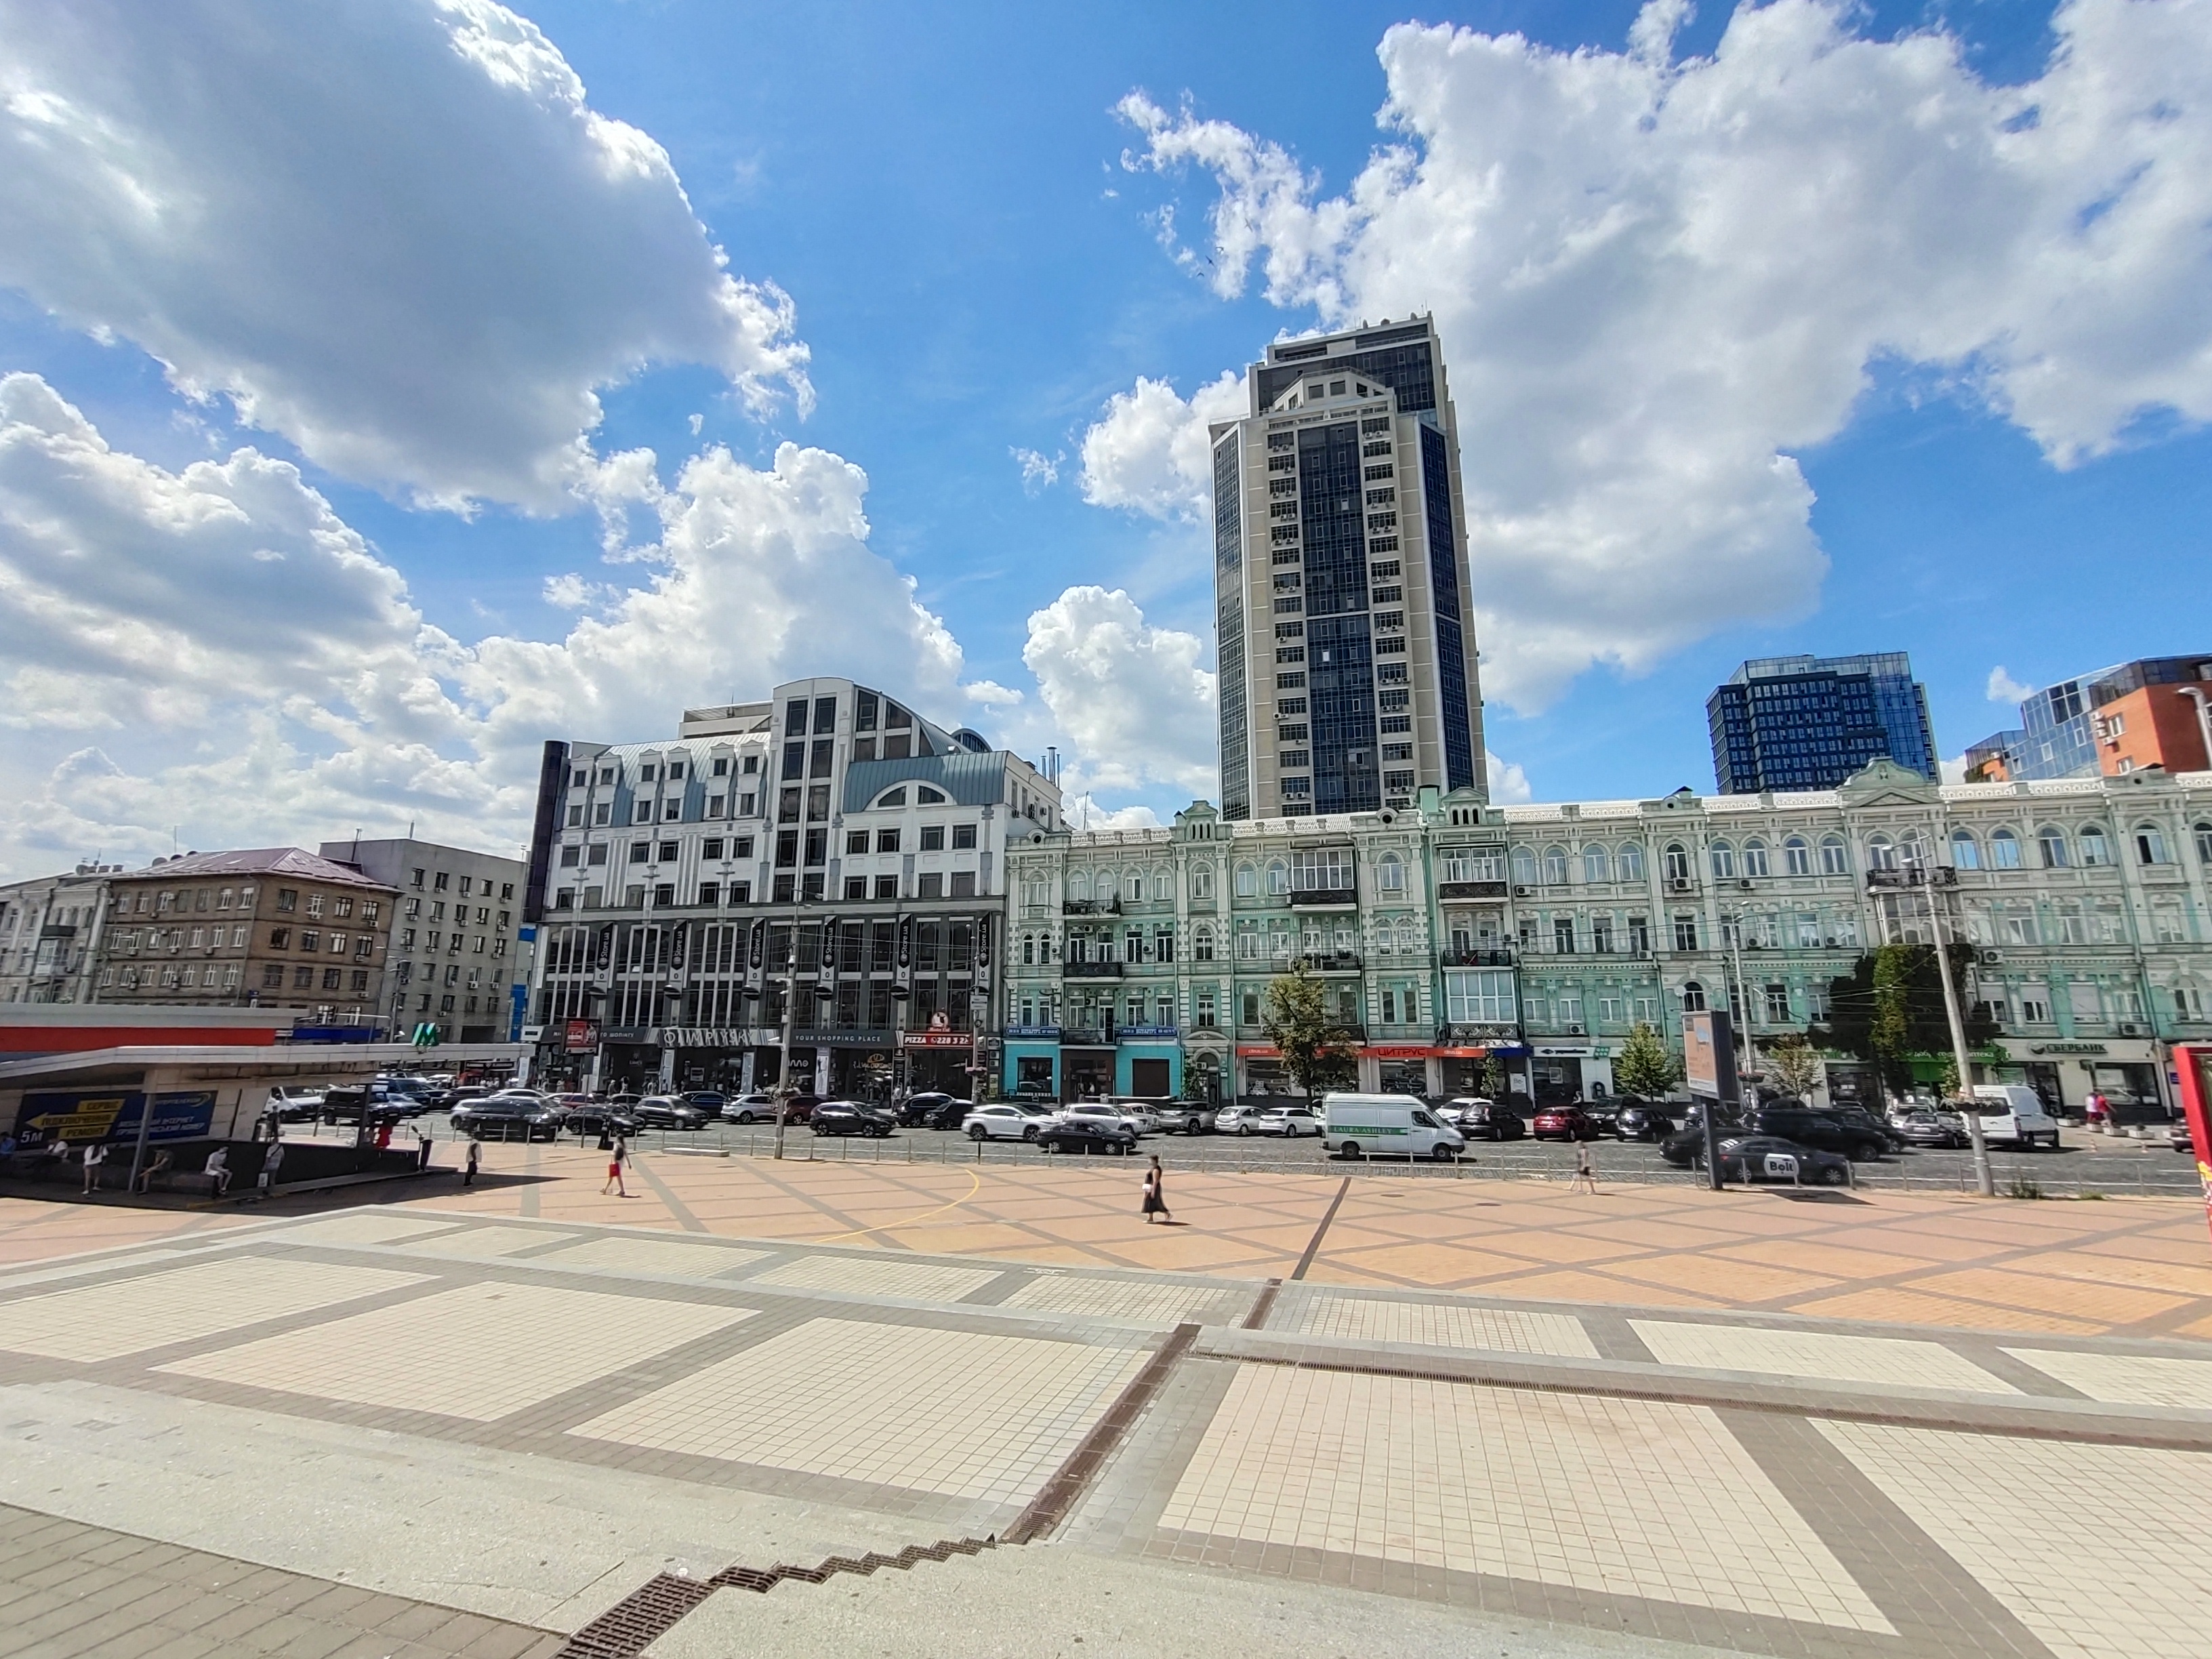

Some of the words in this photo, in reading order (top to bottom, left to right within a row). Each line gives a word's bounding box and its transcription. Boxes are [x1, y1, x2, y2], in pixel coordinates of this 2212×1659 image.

[1378, 1048, 1426, 1056] ЦИТРУС
[2046, 1043, 2108, 1052] СБЕРБАНК
[66, 1127, 105, 1137] РЕМОНТ
[1769, 1161, 1794, 1172] Bolt
